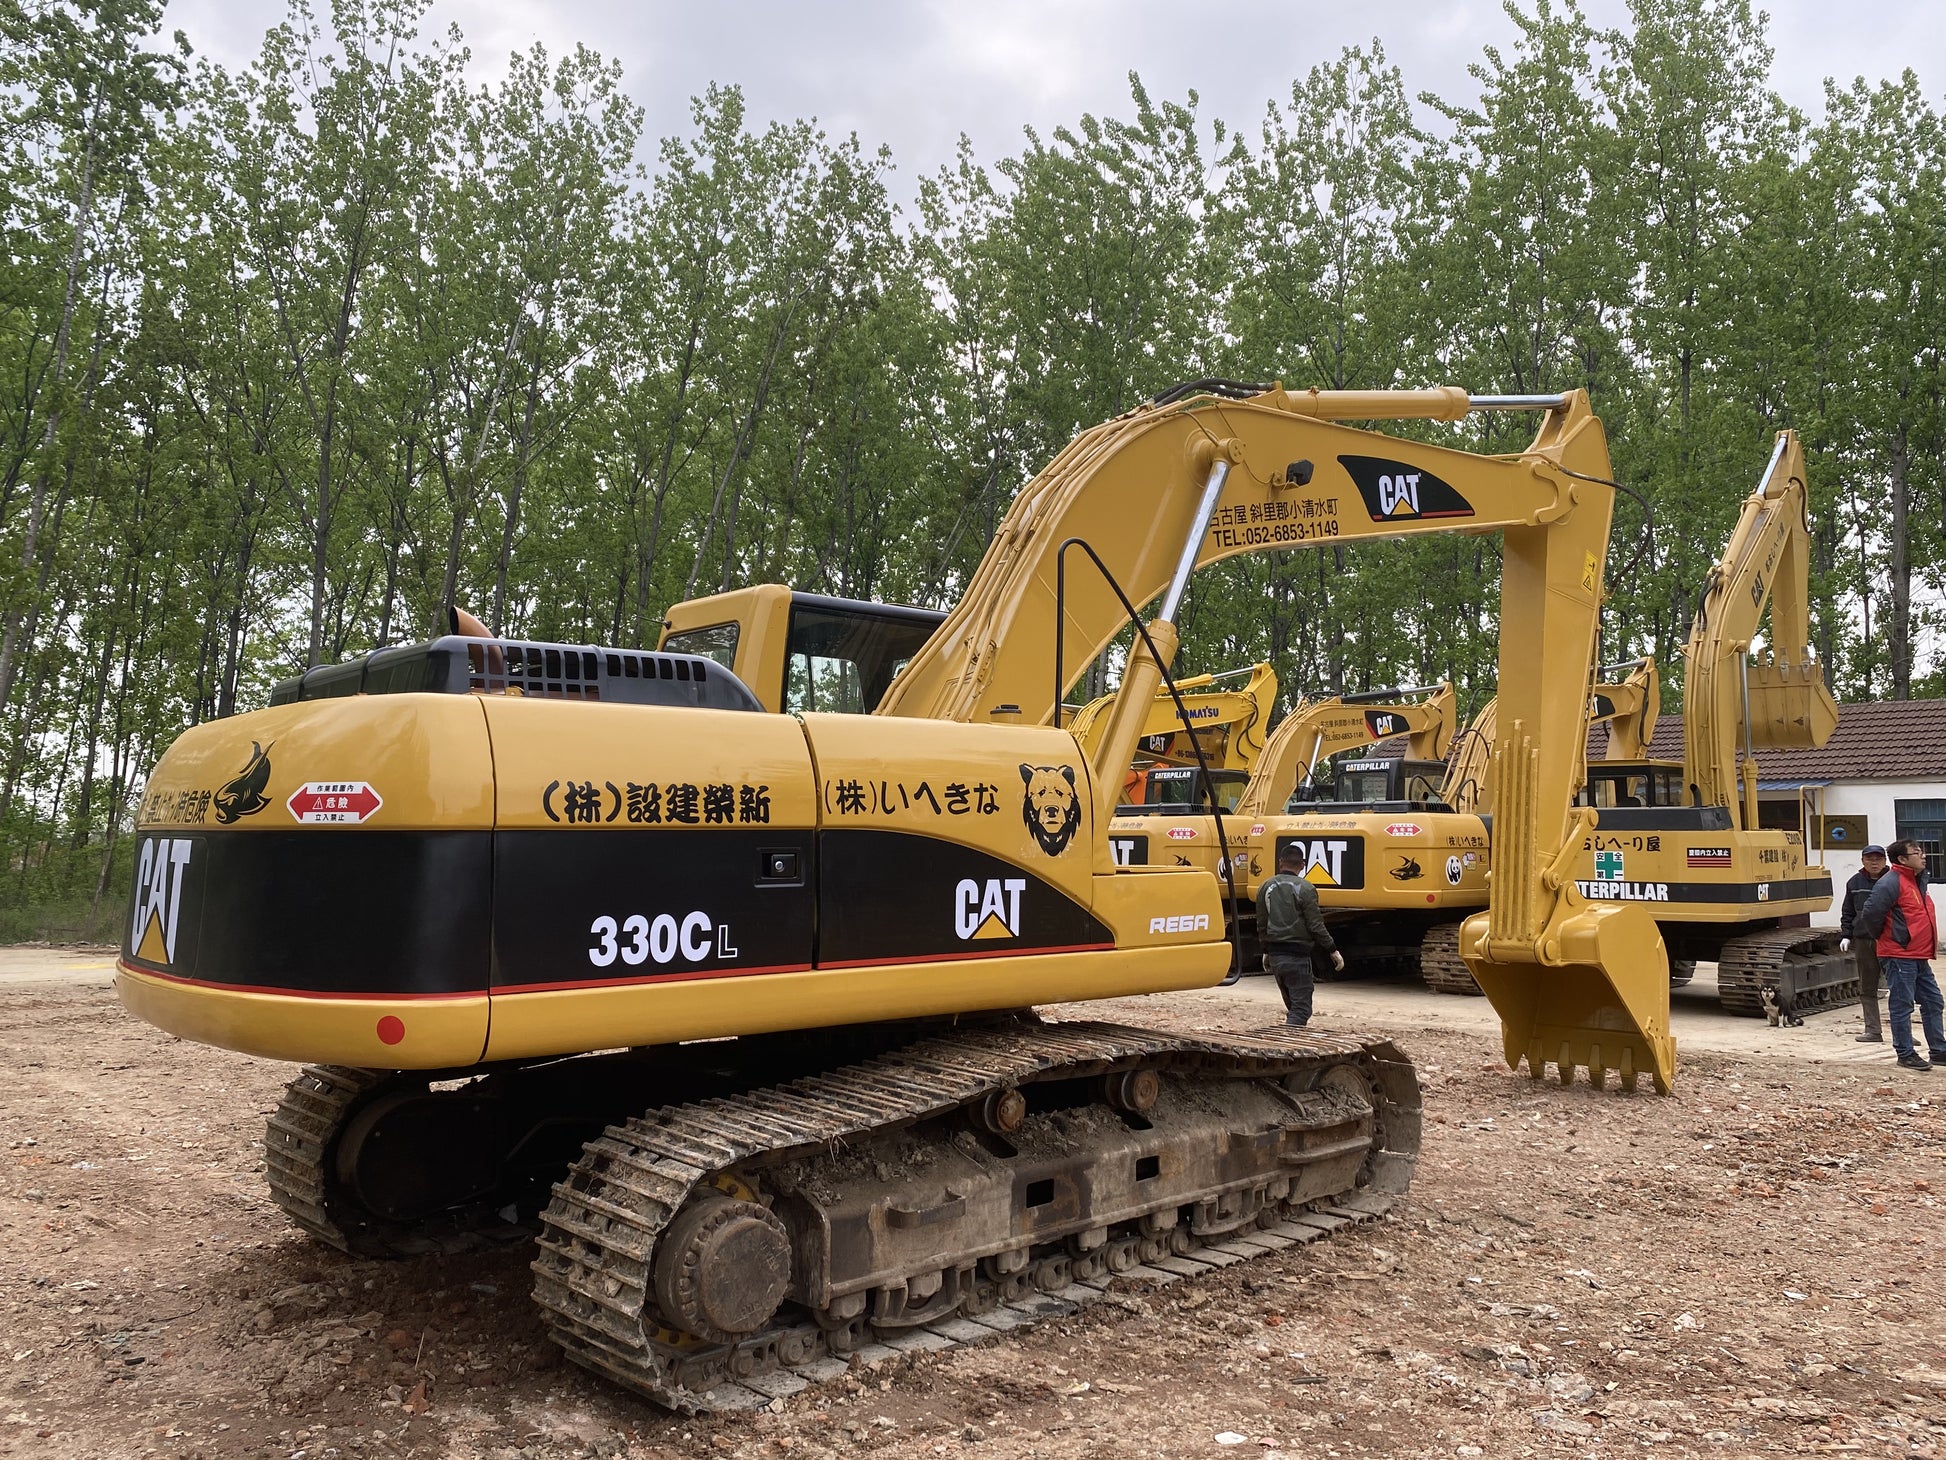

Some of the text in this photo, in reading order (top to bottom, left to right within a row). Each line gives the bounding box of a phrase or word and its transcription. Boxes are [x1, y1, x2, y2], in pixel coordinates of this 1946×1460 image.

[1378, 472, 1419, 516] CAT
[1213, 520, 1339, 547] TEL:052-6853-1149
[1376, 715, 1393, 736] CAT
[1149, 736, 1165, 751] CAT
[1346, 762, 1390, 772] CATERPILLAR
[1614, 852, 1622, 860] 全
[131, 837, 192, 964] CAT
[1575, 881, 1669, 901] TERPILLAR
[1758, 884, 1769, 900] CAT
[956, 879, 1025, 940] CAT
[589, 911, 738, 967] 330C L
